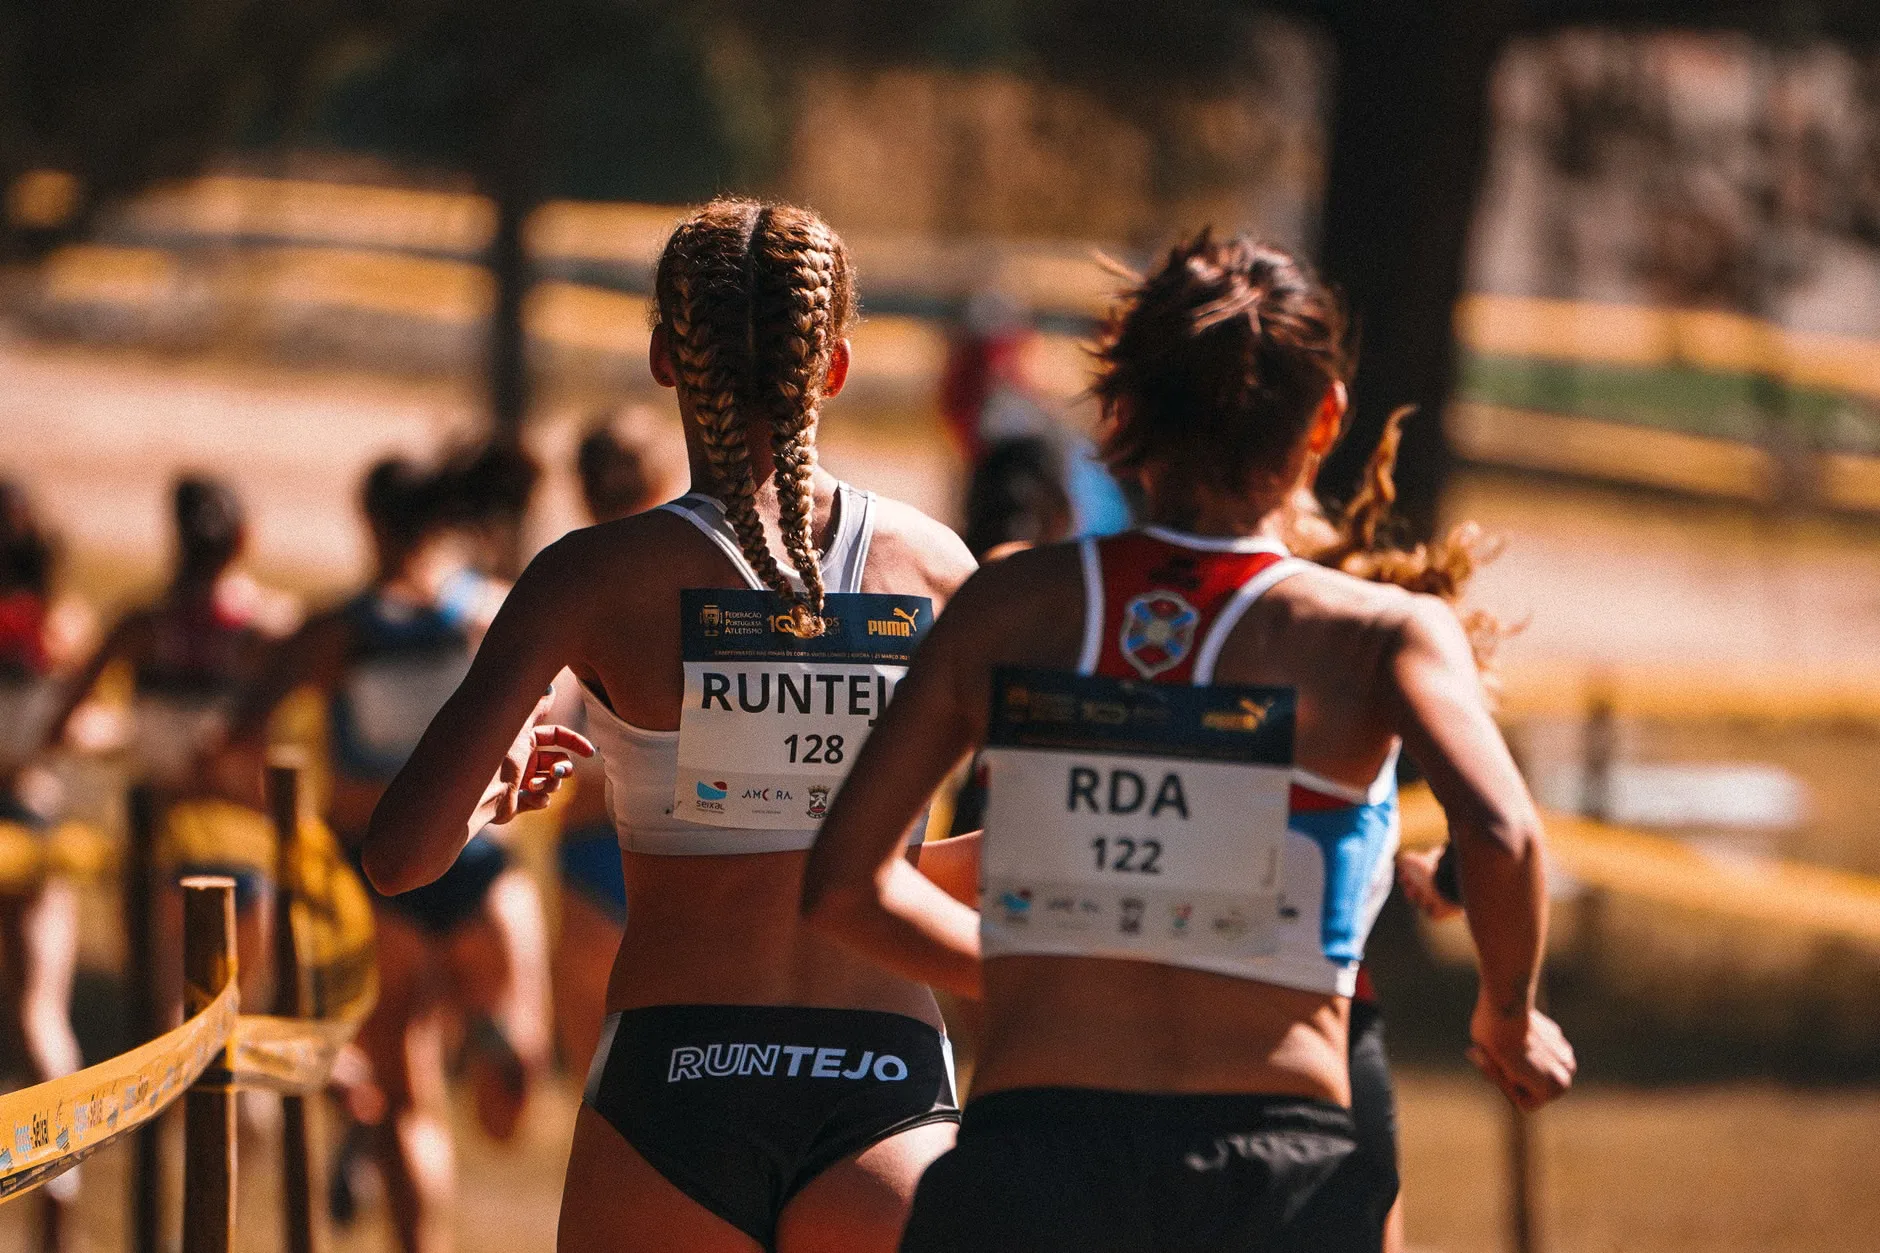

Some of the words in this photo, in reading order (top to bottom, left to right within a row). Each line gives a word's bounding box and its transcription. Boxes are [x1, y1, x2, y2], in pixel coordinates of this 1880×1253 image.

[868, 620, 910, 637] PUMA
[701, 672, 888, 728] RUNTEJ
[783, 733, 845, 764] 128
[1066, 765, 1192, 821] RDA
[1091, 836, 1163, 874] 122
[668, 1043, 908, 1083] RUNTEJO
